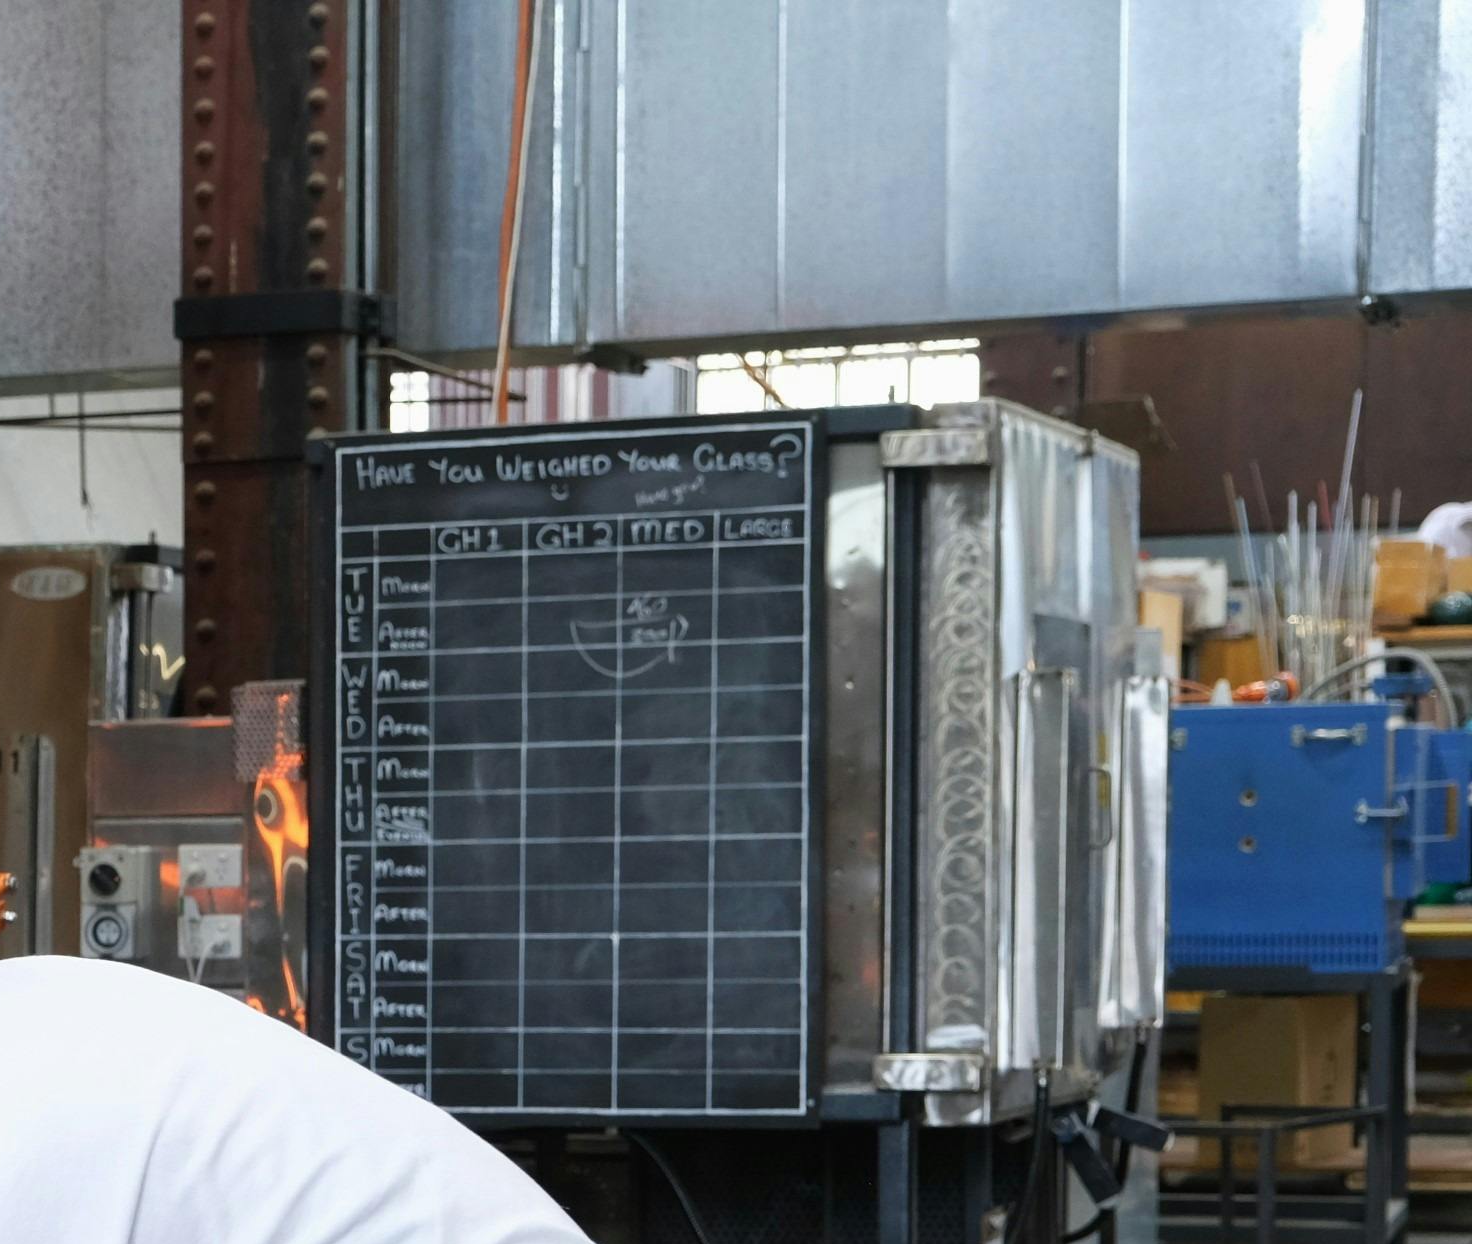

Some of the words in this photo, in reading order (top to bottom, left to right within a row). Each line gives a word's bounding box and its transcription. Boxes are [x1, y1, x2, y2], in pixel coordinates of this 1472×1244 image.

[357, 456, 416, 491] HAVE
[428, 456, 484, 485] YOU
[496, 453, 613, 482] WEIGHED
[617, 449, 682, 474] YOUR
[631, 519, 705, 545] MED
[724, 516, 795, 541] LARGE
